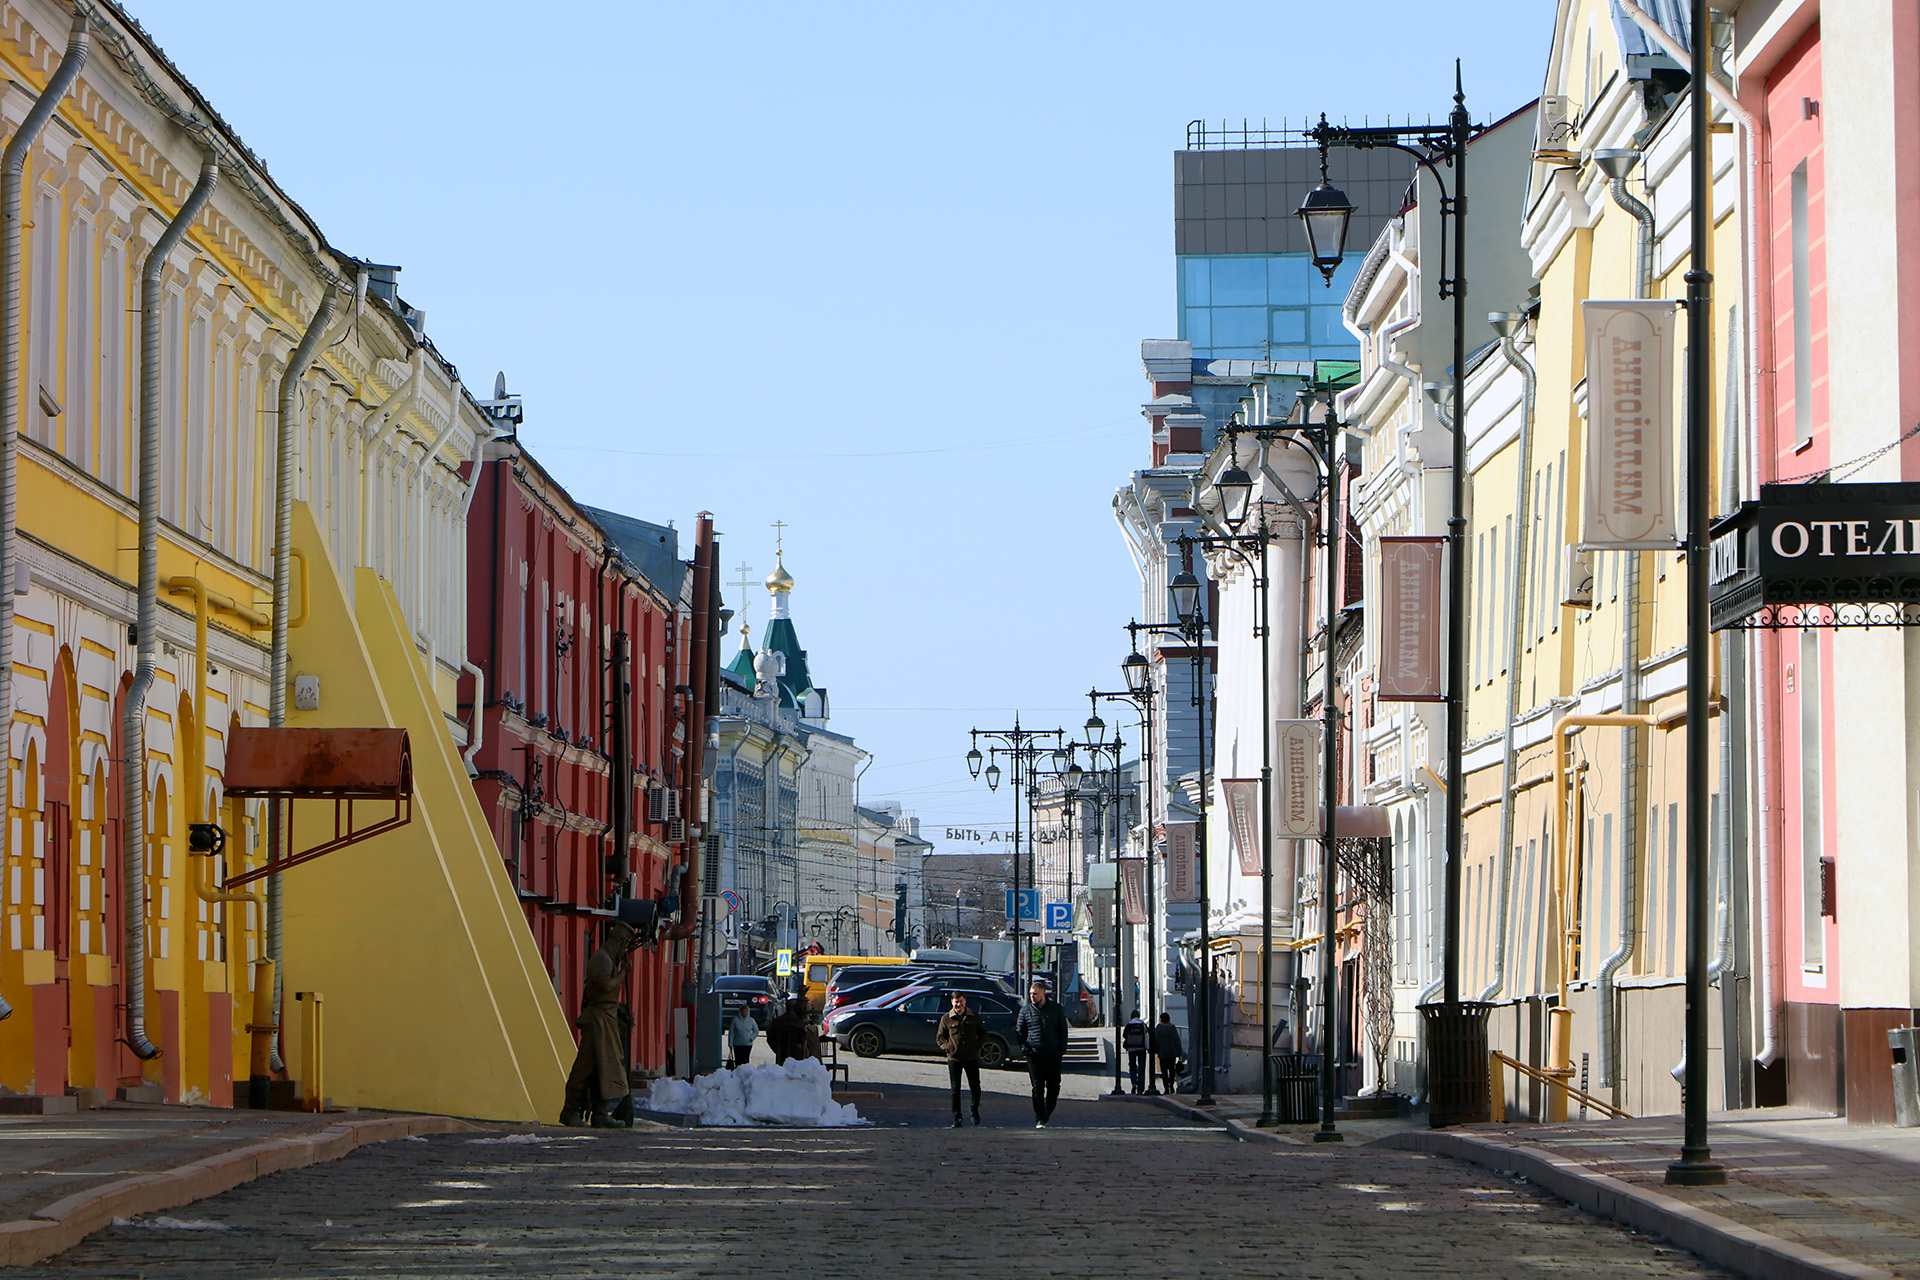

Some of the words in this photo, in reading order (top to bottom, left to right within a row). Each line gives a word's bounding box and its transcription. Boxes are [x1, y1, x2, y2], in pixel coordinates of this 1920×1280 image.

[946, 828, 984, 846] БЫТЬ,
[989, 831, 1000, 842] А
[1005, 831, 1023, 842] НЕ
[1013, 892, 1029, 915] P
[1053, 906, 1068, 927] P
